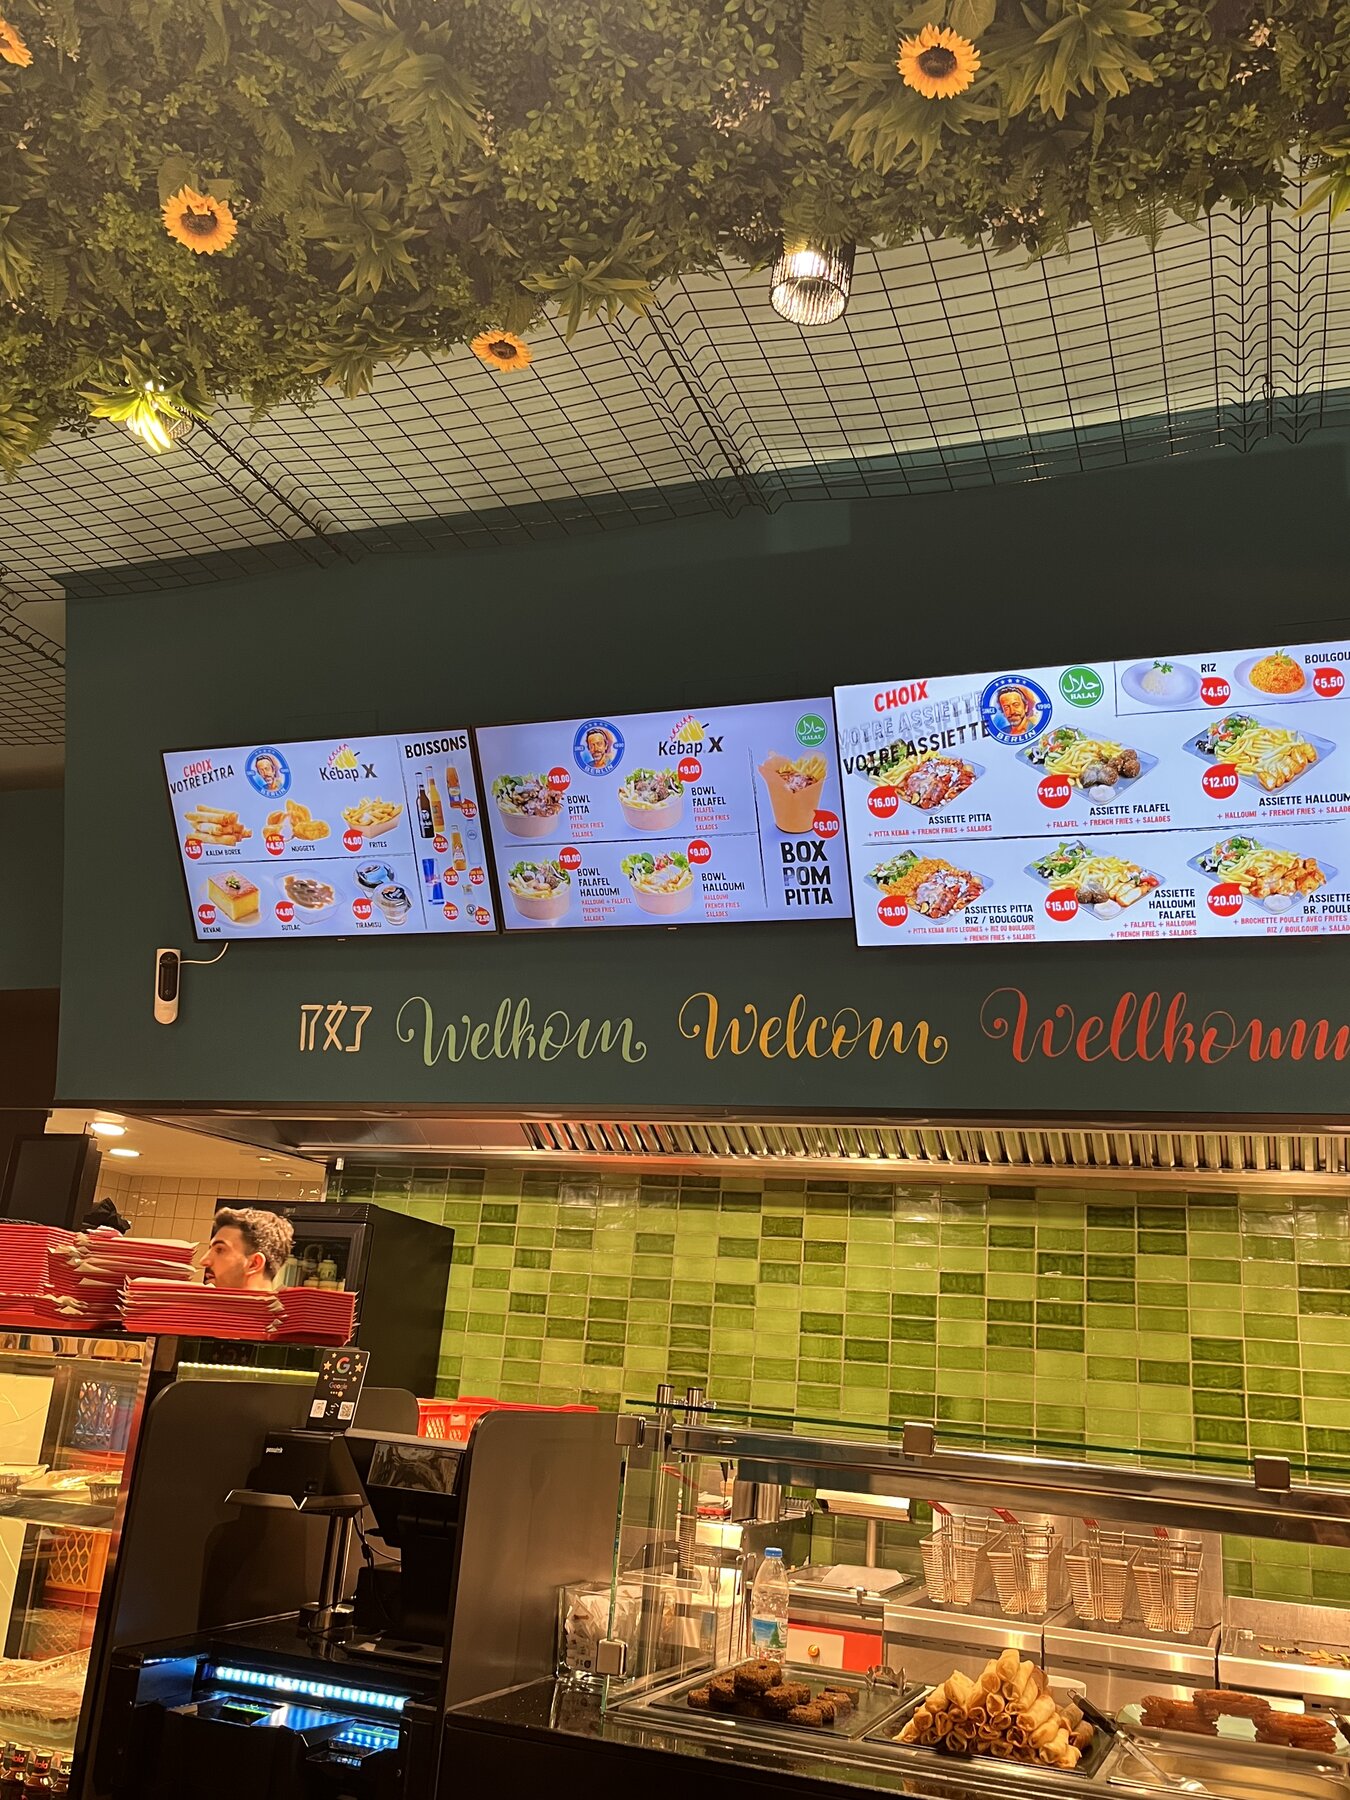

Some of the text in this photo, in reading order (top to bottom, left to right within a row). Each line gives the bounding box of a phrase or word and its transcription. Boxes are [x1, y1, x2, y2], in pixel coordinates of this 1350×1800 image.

[1304, 651, 1350, 664] BOULGOU
[1201, 663, 1216, 673] RIZ
[1314, 676, 1344, 689] €5.50
[874, 680, 929, 712] CHOIX
[1070, 692, 1098, 700] HALAL
[1202, 685, 1230, 698] €4.50
[996, 730, 1036, 742] BERLIN
[405, 735, 467, 759] BOISSONS
[659, 736, 724, 757] Kébap X
[843, 720, 991, 775] VOTRE ASSIETTE
[183, 758, 212, 778] CHOIX
[319, 763, 378, 782] Kébap X
[679, 765, 700, 774] €9.00
[170, 764, 234, 794] VOTRE EXTRA
[549, 774, 570, 784] €10.00
[1203, 775, 1236, 788] €12.00
[691, 786, 716, 796] BOWL
[1038, 787, 1068, 798] €12.00
[567, 795, 590, 804] BOWL
[693, 797, 726, 806] FALAFEL
[868, 797, 896, 808] €16.00
[1259, 796, 1301, 806] ASSIETTE
[569, 806, 590, 814] PITTA
[1090, 804, 1170, 816] ASSIETTE FALAFEL
[1224, 811, 1257, 819] HALLOUMI
[929, 813, 992, 824] ASSIETTE PITTA
[814, 820, 839, 832] €6.00
[942, 826, 957, 834] FRIES
[689, 847, 710, 856] €9.00
[780, 840, 828, 863] BOX
[560, 854, 580, 863] €10.00
[577, 868, 600, 876] BOWL
[701, 872, 726, 881] BOWL
[783, 866, 831, 887] POM
[579, 878, 610, 886] FALAFEL
[703, 882, 745, 891] HALLOUMI
[580, 888, 620, 897] HALLOUMI
[785, 887, 833, 906] PITTA
[1154, 889, 1195, 898] ASSIETTE
[1208, 895, 1242, 907] €20.00
[1308, 894, 1350, 903] ASSIETTE
[1046, 900, 1076, 912] €15.00
[1149, 899, 1195, 909] HALLOUMI
[878, 906, 906, 917] €18.00
[964, 905, 1033, 914] ASSIETTES PITTA
[1159, 910, 1196, 919] FALAFEL
[1303, 906, 1319, 914] BR.
[965, 916, 978, 924] RIZ
[990, 915, 1034, 924] BOULGOUR
[396, 996, 647, 1067] Welkom
[678, 991, 948, 1064] Welcom
[329, 1382, 348, 1390] Google
